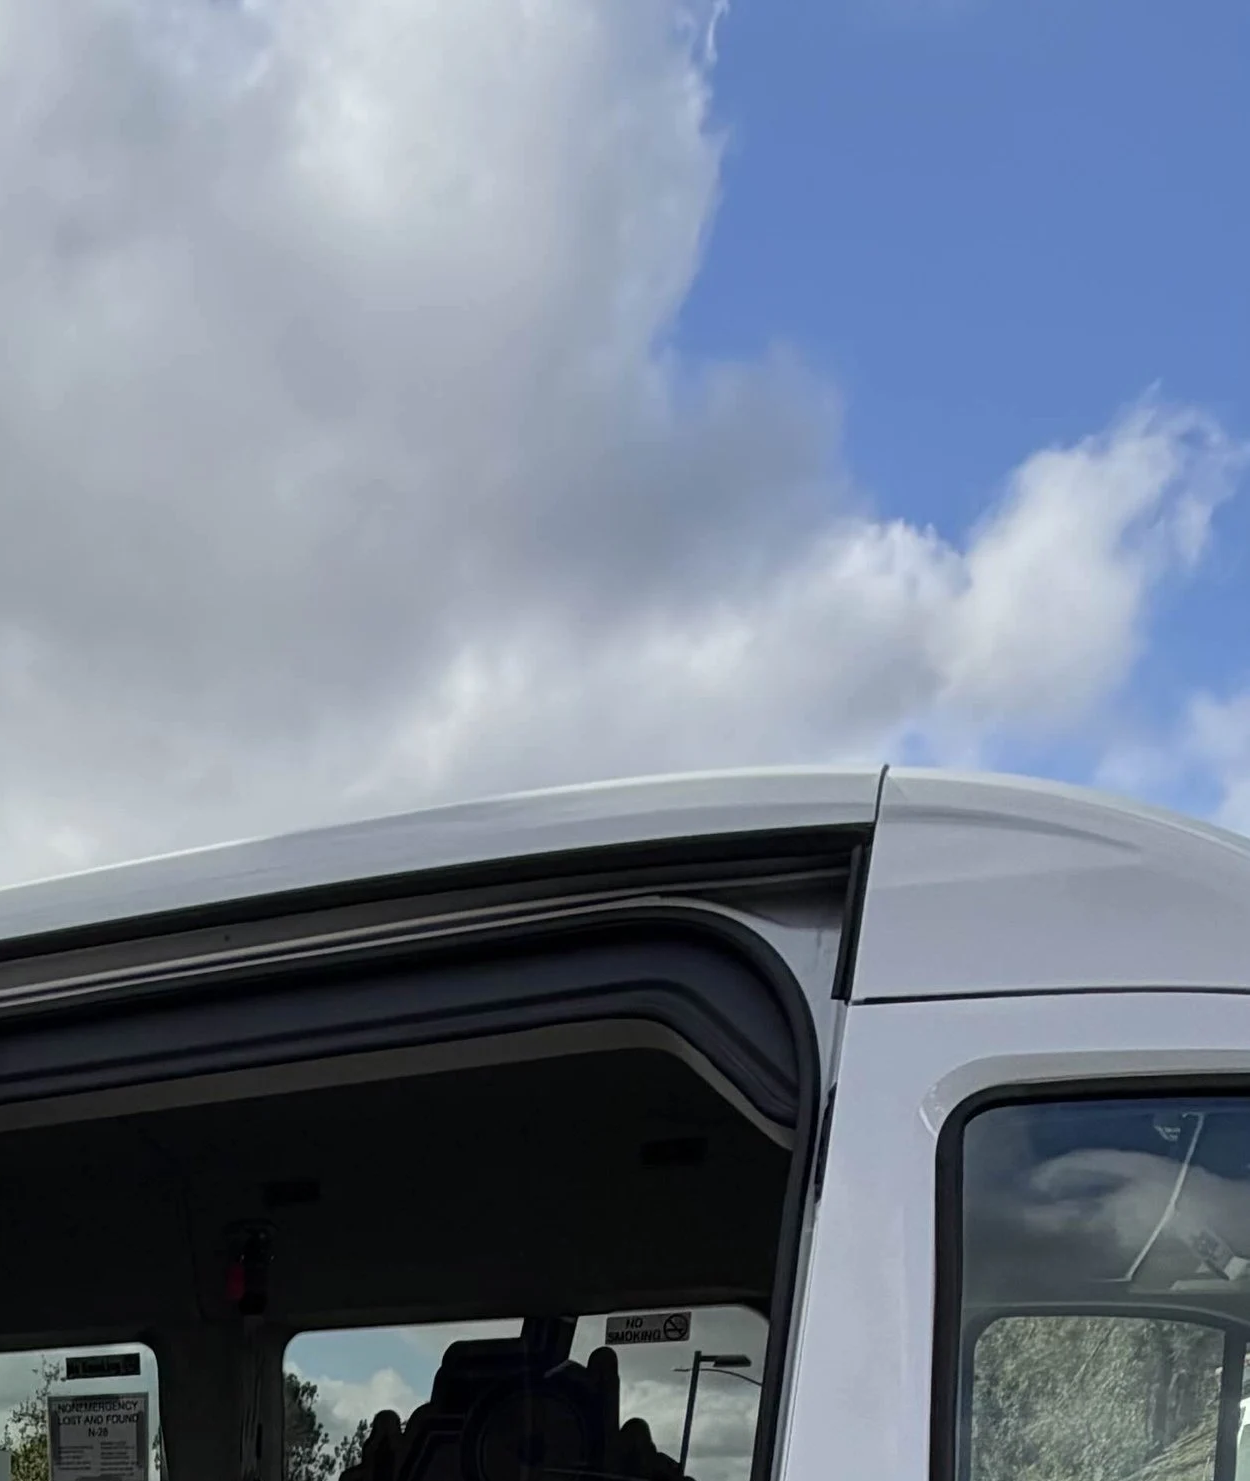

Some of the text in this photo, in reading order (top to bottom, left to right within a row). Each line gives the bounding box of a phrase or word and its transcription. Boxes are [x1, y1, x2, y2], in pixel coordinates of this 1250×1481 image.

[626, 1317, 643, 1329] NO
[608, 1329, 661, 1342] SMOKING
[58, 1413, 139, 1425] LOST AND FOUND
